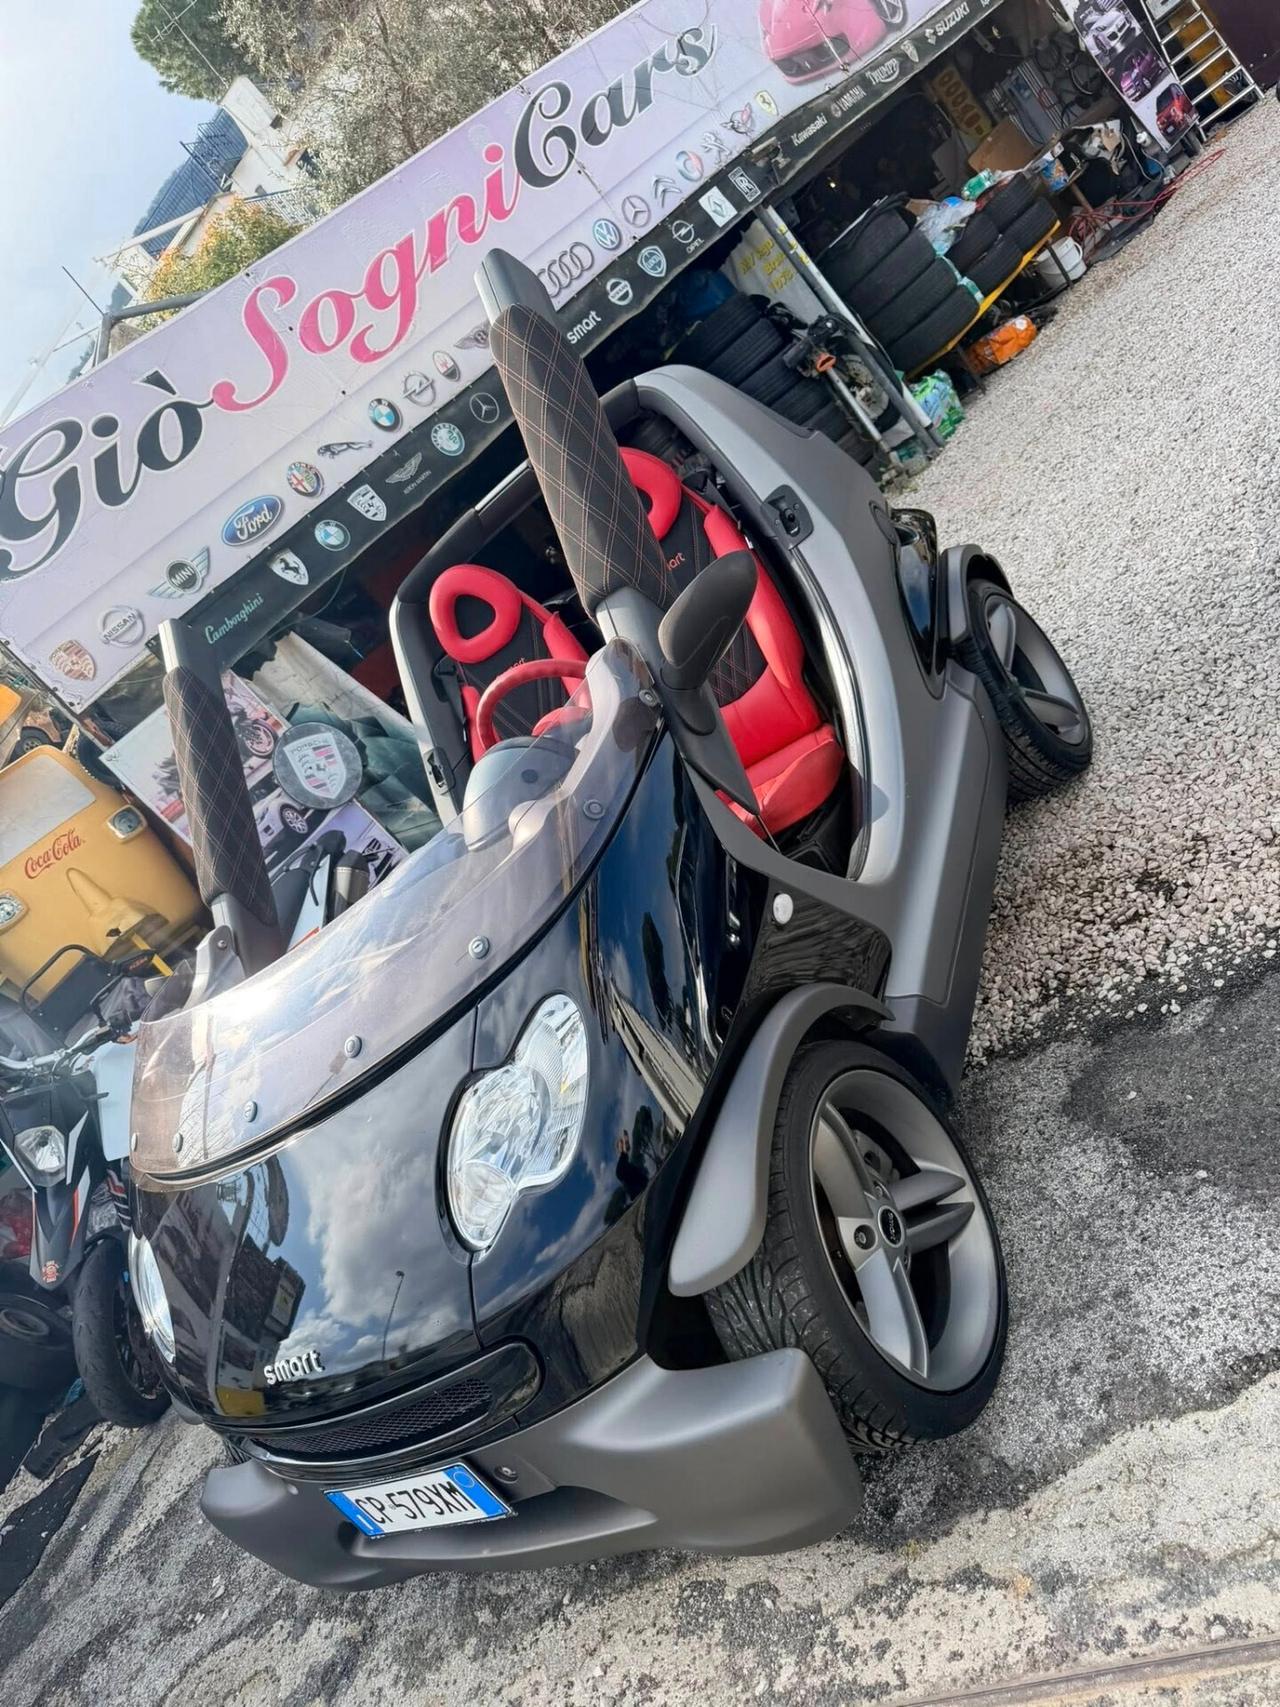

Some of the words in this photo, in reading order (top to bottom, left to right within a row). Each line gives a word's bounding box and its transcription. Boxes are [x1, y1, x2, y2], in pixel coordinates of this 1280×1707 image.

[935, 2, 970, 36] SUZUKI
[838, 85, 866, 116] YAMAHA
[791, 113, 828, 147] Kawasaki
[686, 237, 705, 254] OPEL
[0, 370, 205, 581] Giò
[211, 142, 521, 412] Sogni
[514, 23, 718, 188] Cars
[566, 310, 602, 345] smart
[234, 503, 273, 541] Ford
[171, 565, 195, 586] MINI
[103, 609, 138, 645] NISSAN
[205, 593, 265, 646] Lamborghini
[24, 828, 82, 880] Coca-Cola
[263, 1350, 326, 1385] smart
